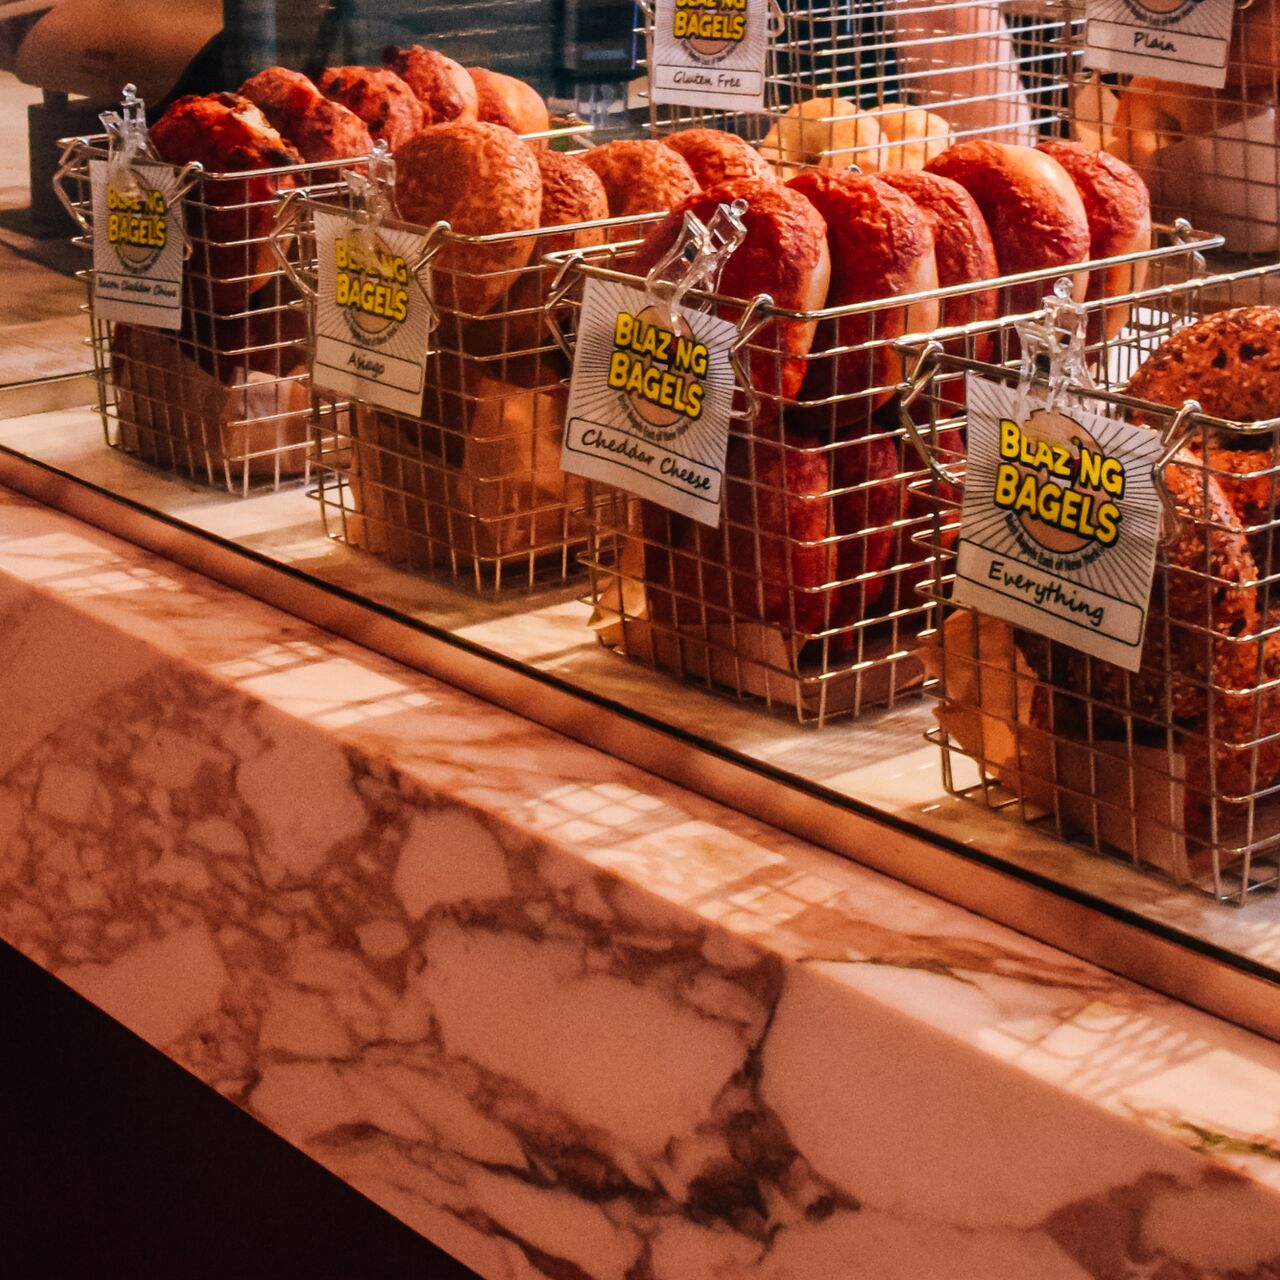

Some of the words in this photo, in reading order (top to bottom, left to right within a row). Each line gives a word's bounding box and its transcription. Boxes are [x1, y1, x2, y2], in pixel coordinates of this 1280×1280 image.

[673, 9, 746, 41] BAGELS
[1134, 31, 1177, 53] Plain
[673, 71, 712, 86] Gluten
[717, 73, 741, 88] Free
[108, 214, 167, 249] BAGELS
[335, 271, 410, 324] BAGELS
[347, 352, 385, 378] Asiago
[607, 350, 705, 420] BAGELS
[581, 429, 654, 464] Cheddar
[659, 458, 712, 491] Cheese
[994, 463, 1122, 547] BAGELS
[988, 560, 1105, 626] Everything
